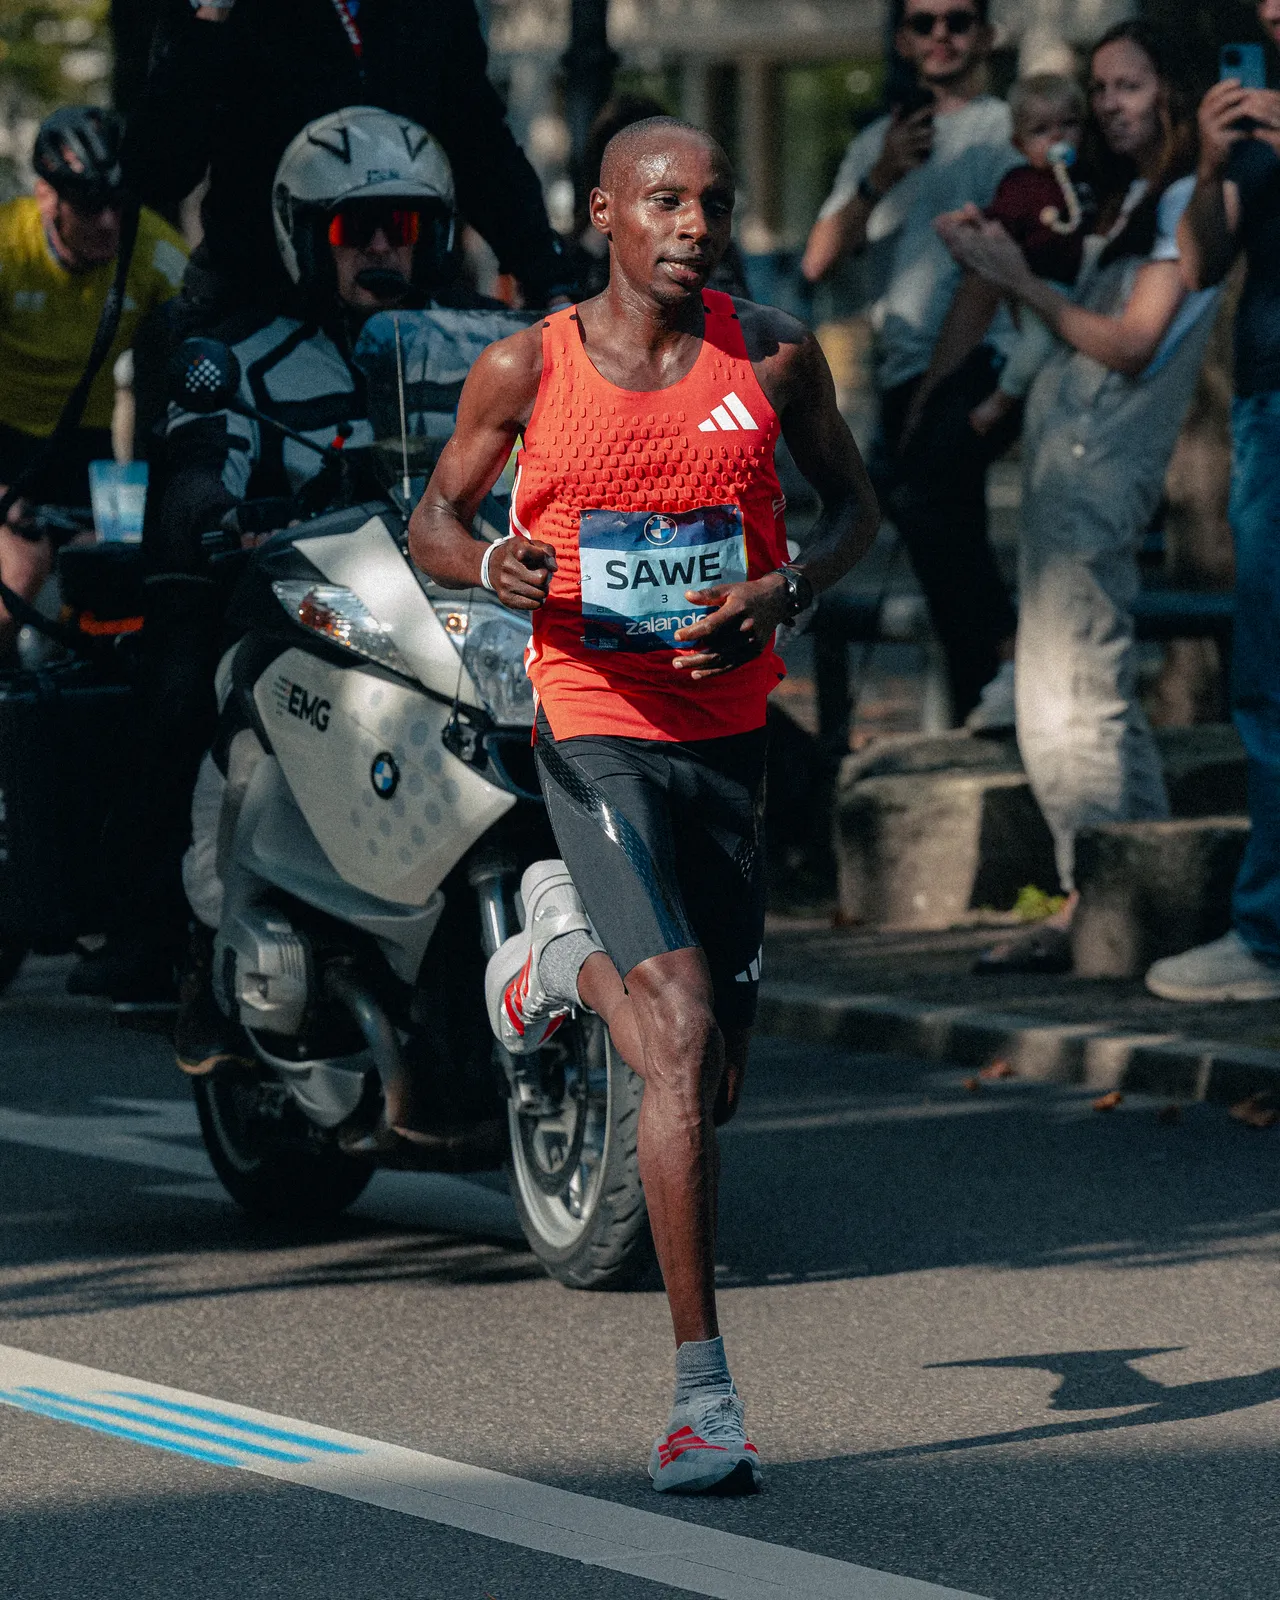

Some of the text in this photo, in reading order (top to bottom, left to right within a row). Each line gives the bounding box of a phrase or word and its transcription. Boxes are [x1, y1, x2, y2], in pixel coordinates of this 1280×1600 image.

[605, 551, 722, 590] SAWE
[661, 594, 669, 604] 3
[288, 683, 332, 732] EMG
